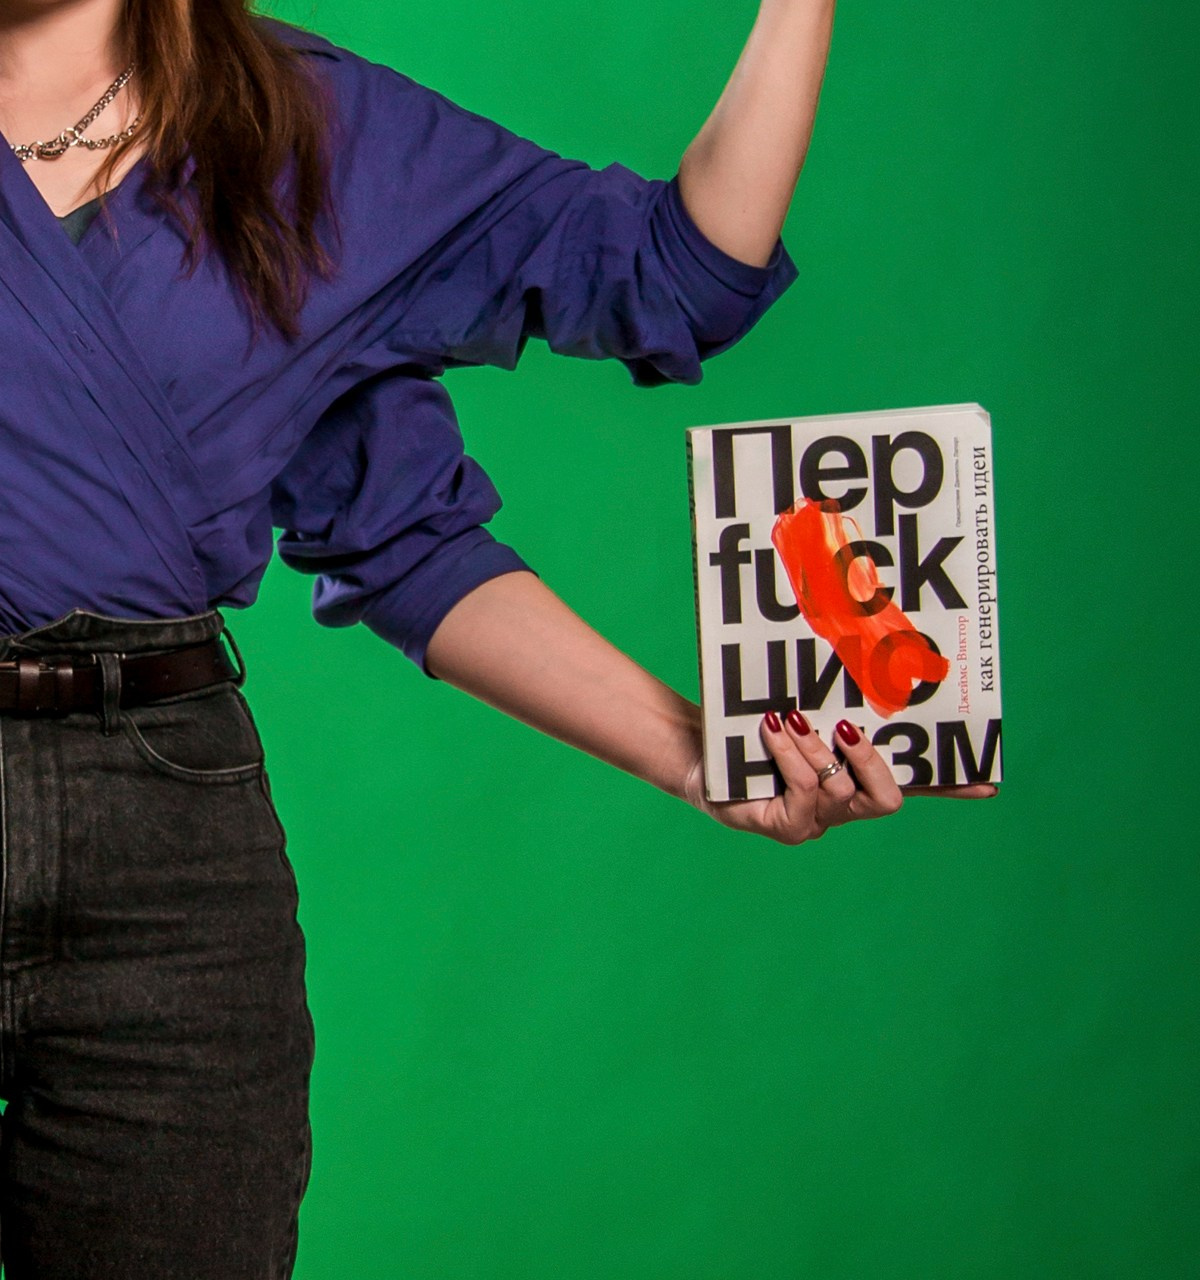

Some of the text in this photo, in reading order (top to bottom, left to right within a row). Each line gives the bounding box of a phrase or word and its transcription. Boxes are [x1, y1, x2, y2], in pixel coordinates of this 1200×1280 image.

[711, 424, 945, 537] Пер
[709, 513, 970, 625] fuck
[973, 445, 997, 693] как генерировать идеи
[956, 614, 970, 714] Джеймс Виктор
